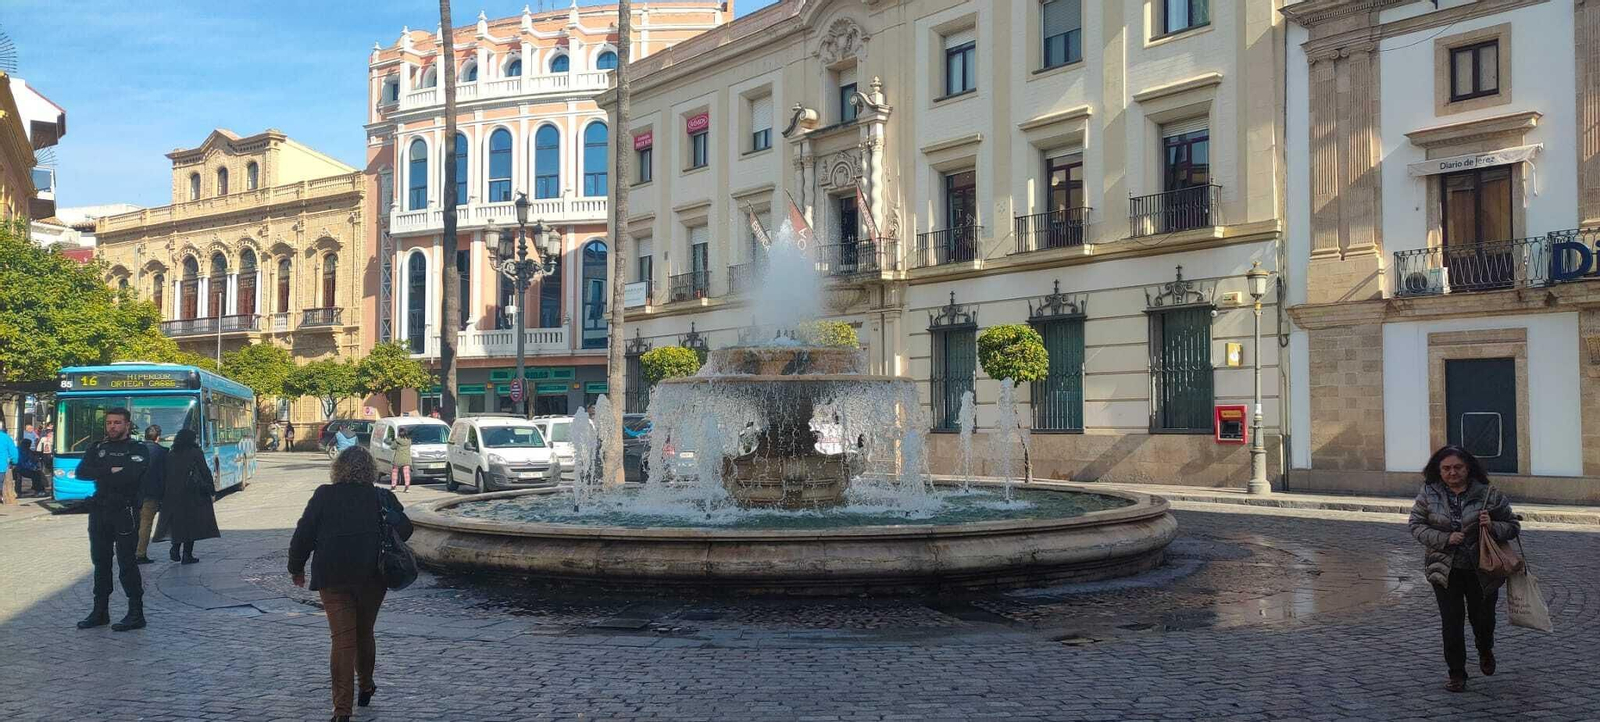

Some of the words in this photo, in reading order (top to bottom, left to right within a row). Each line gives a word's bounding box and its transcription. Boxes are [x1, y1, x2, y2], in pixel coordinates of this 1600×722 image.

[1439, 161, 1463, 170] Diario
[1463, 158, 1474, 167] de
[1474, 156, 1496, 167] Jerez
[60, 380, 73, 388] 85
[80, 375, 98, 386] 16
[110, 380, 144, 388] ORTEGA
